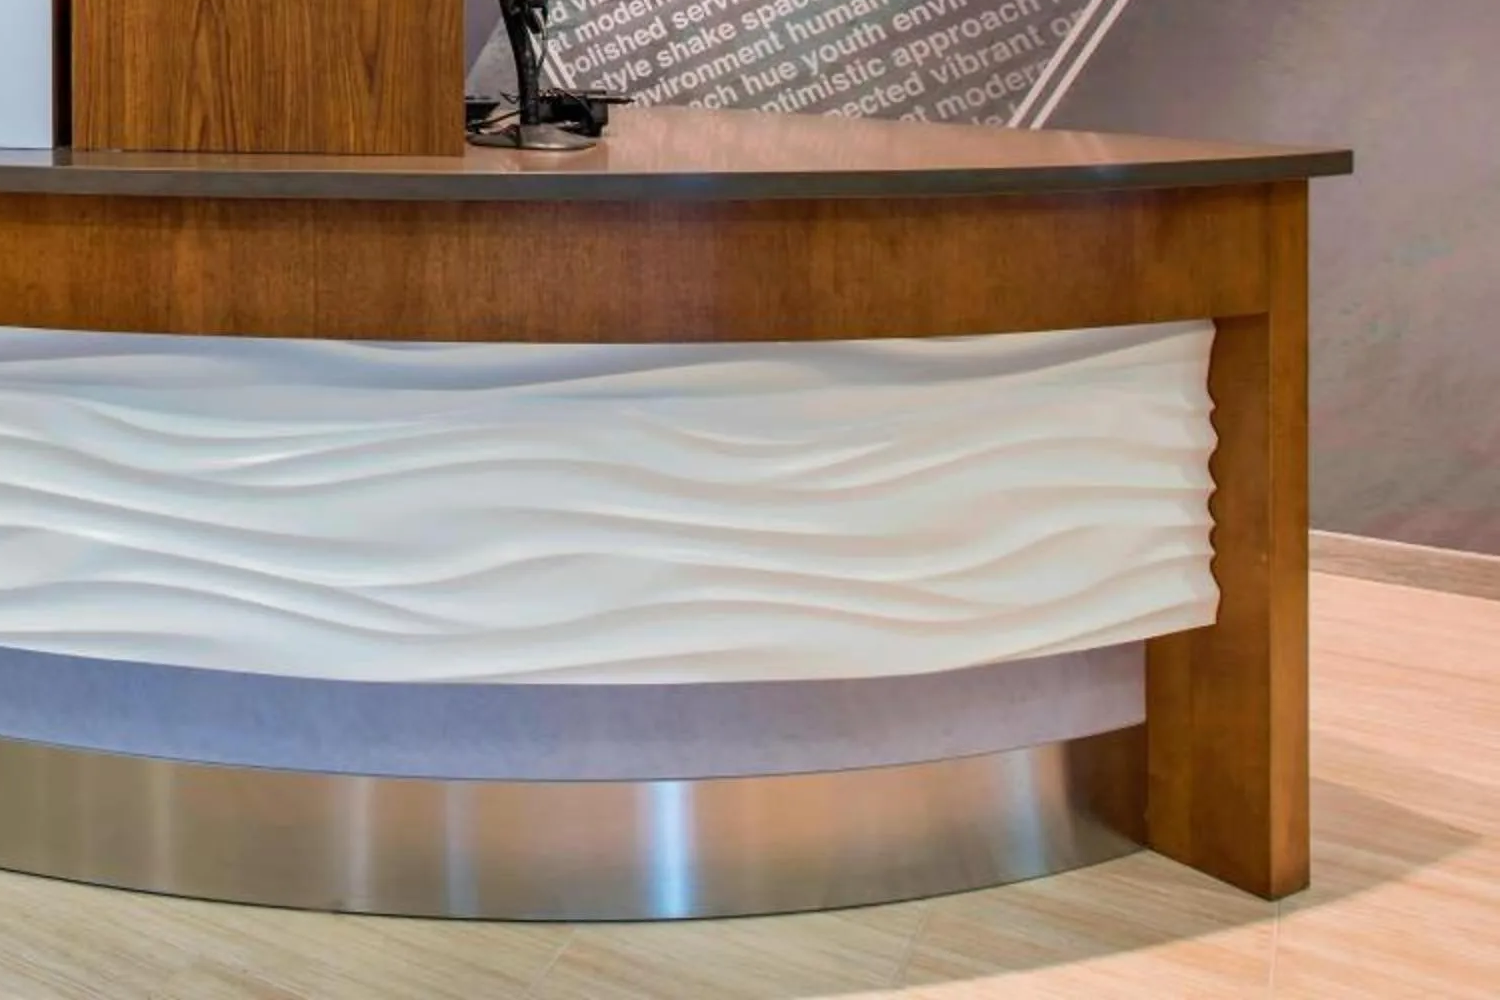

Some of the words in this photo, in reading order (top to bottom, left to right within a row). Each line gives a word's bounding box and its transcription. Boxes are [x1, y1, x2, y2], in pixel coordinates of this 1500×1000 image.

[592, 59, 652, 96] style
[657, 22, 736, 68] shake
[741, 61, 798, 96] hue
[803, 23, 886, 76] youth
[930, 23, 1042, 87] vibrant
